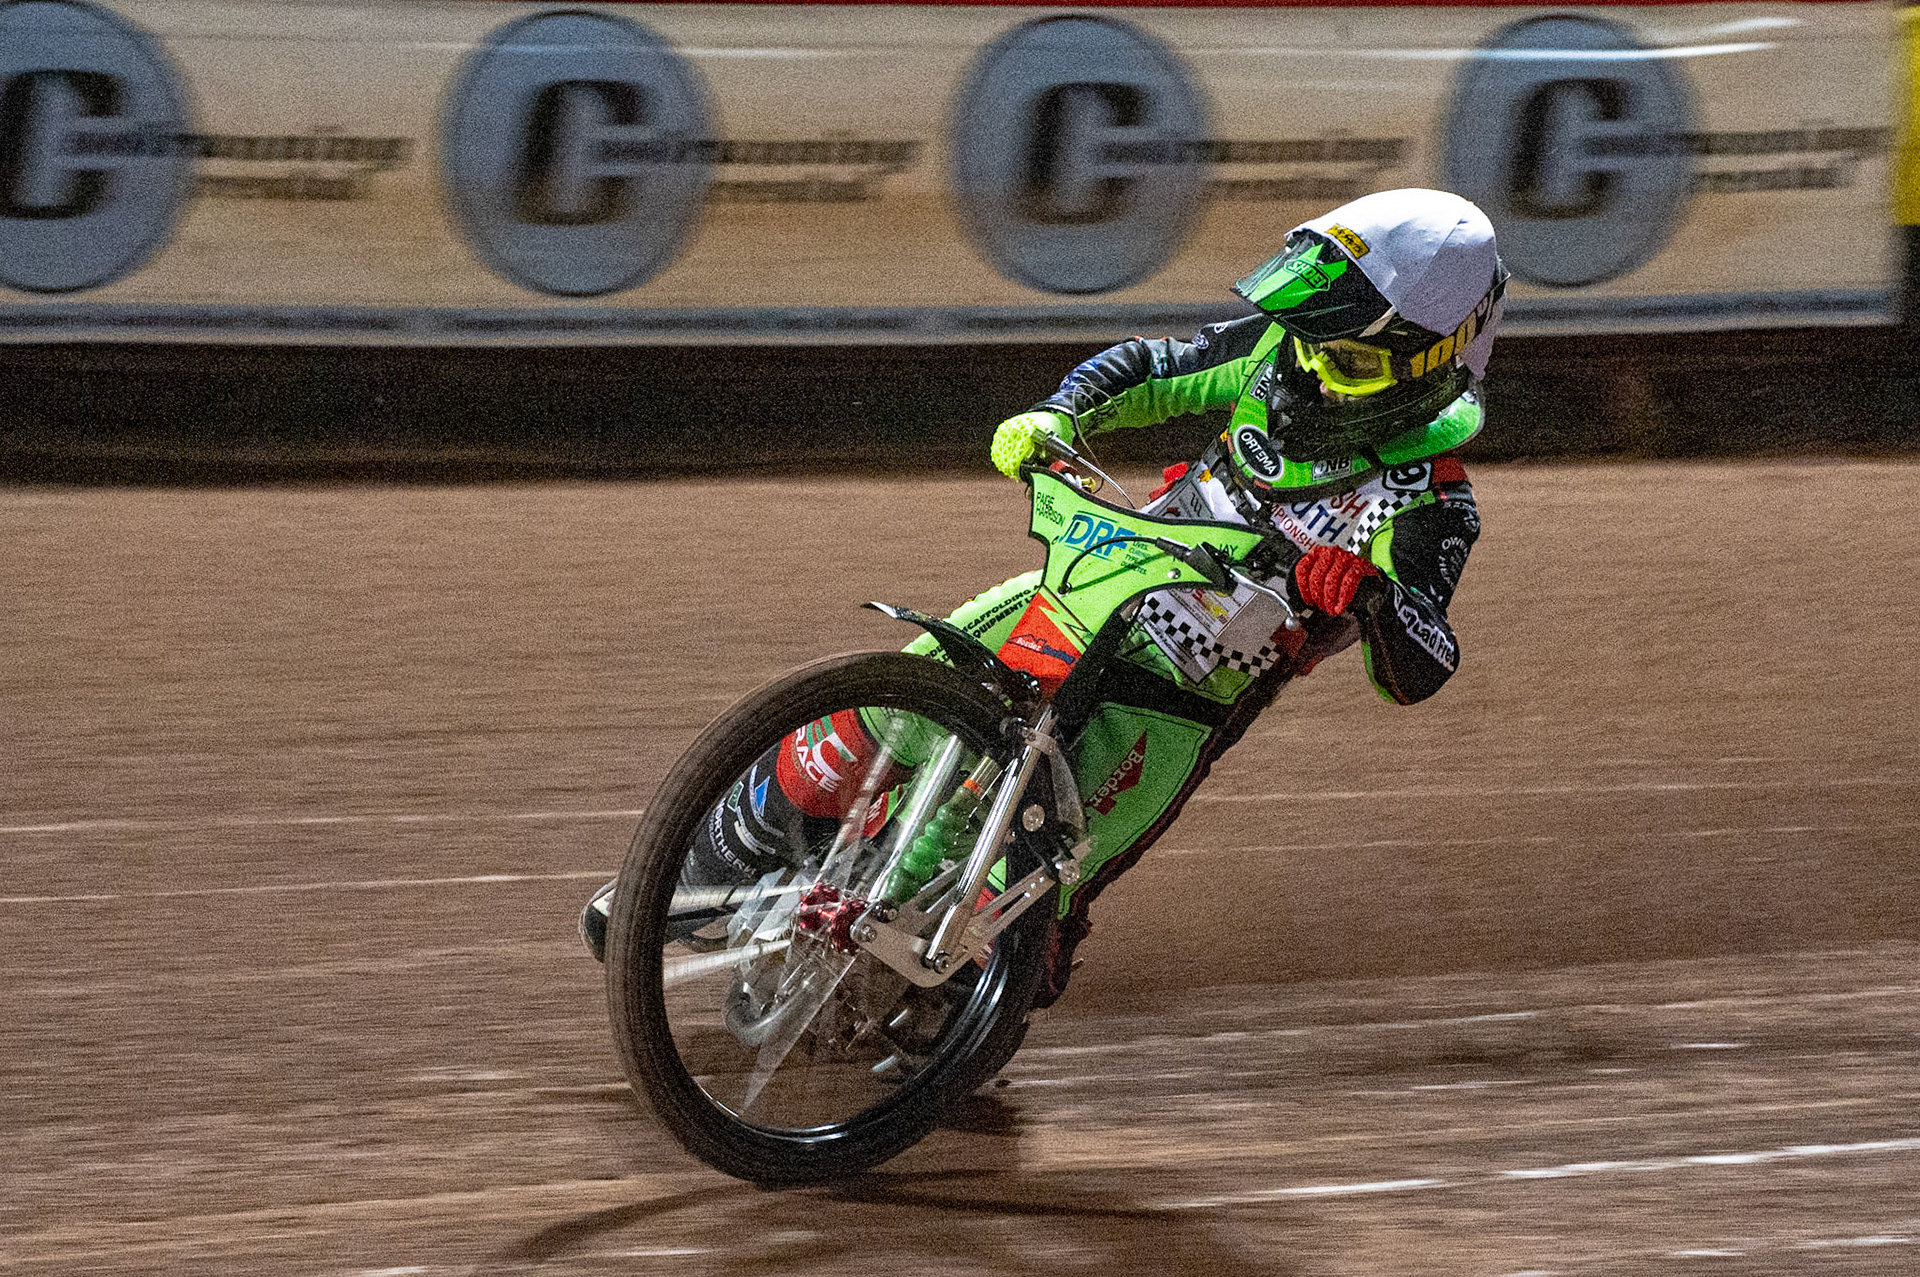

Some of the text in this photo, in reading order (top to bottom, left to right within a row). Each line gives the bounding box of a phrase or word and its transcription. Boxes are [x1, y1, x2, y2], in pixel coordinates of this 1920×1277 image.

[1288, 259, 1327, 289] SHOEI
[1240, 430, 1276, 475] ORTEMA
[1035, 504, 1066, 528] HARRISON
[1036, 491, 1055, 506] PAIGE
[1291, 500, 1348, 543] UTH
[972, 601, 1024, 639] QUIPMENT
[1015, 636, 1042, 651] Border
[795, 725, 839, 793] RACE
[1089, 748, 1144, 807] Border
